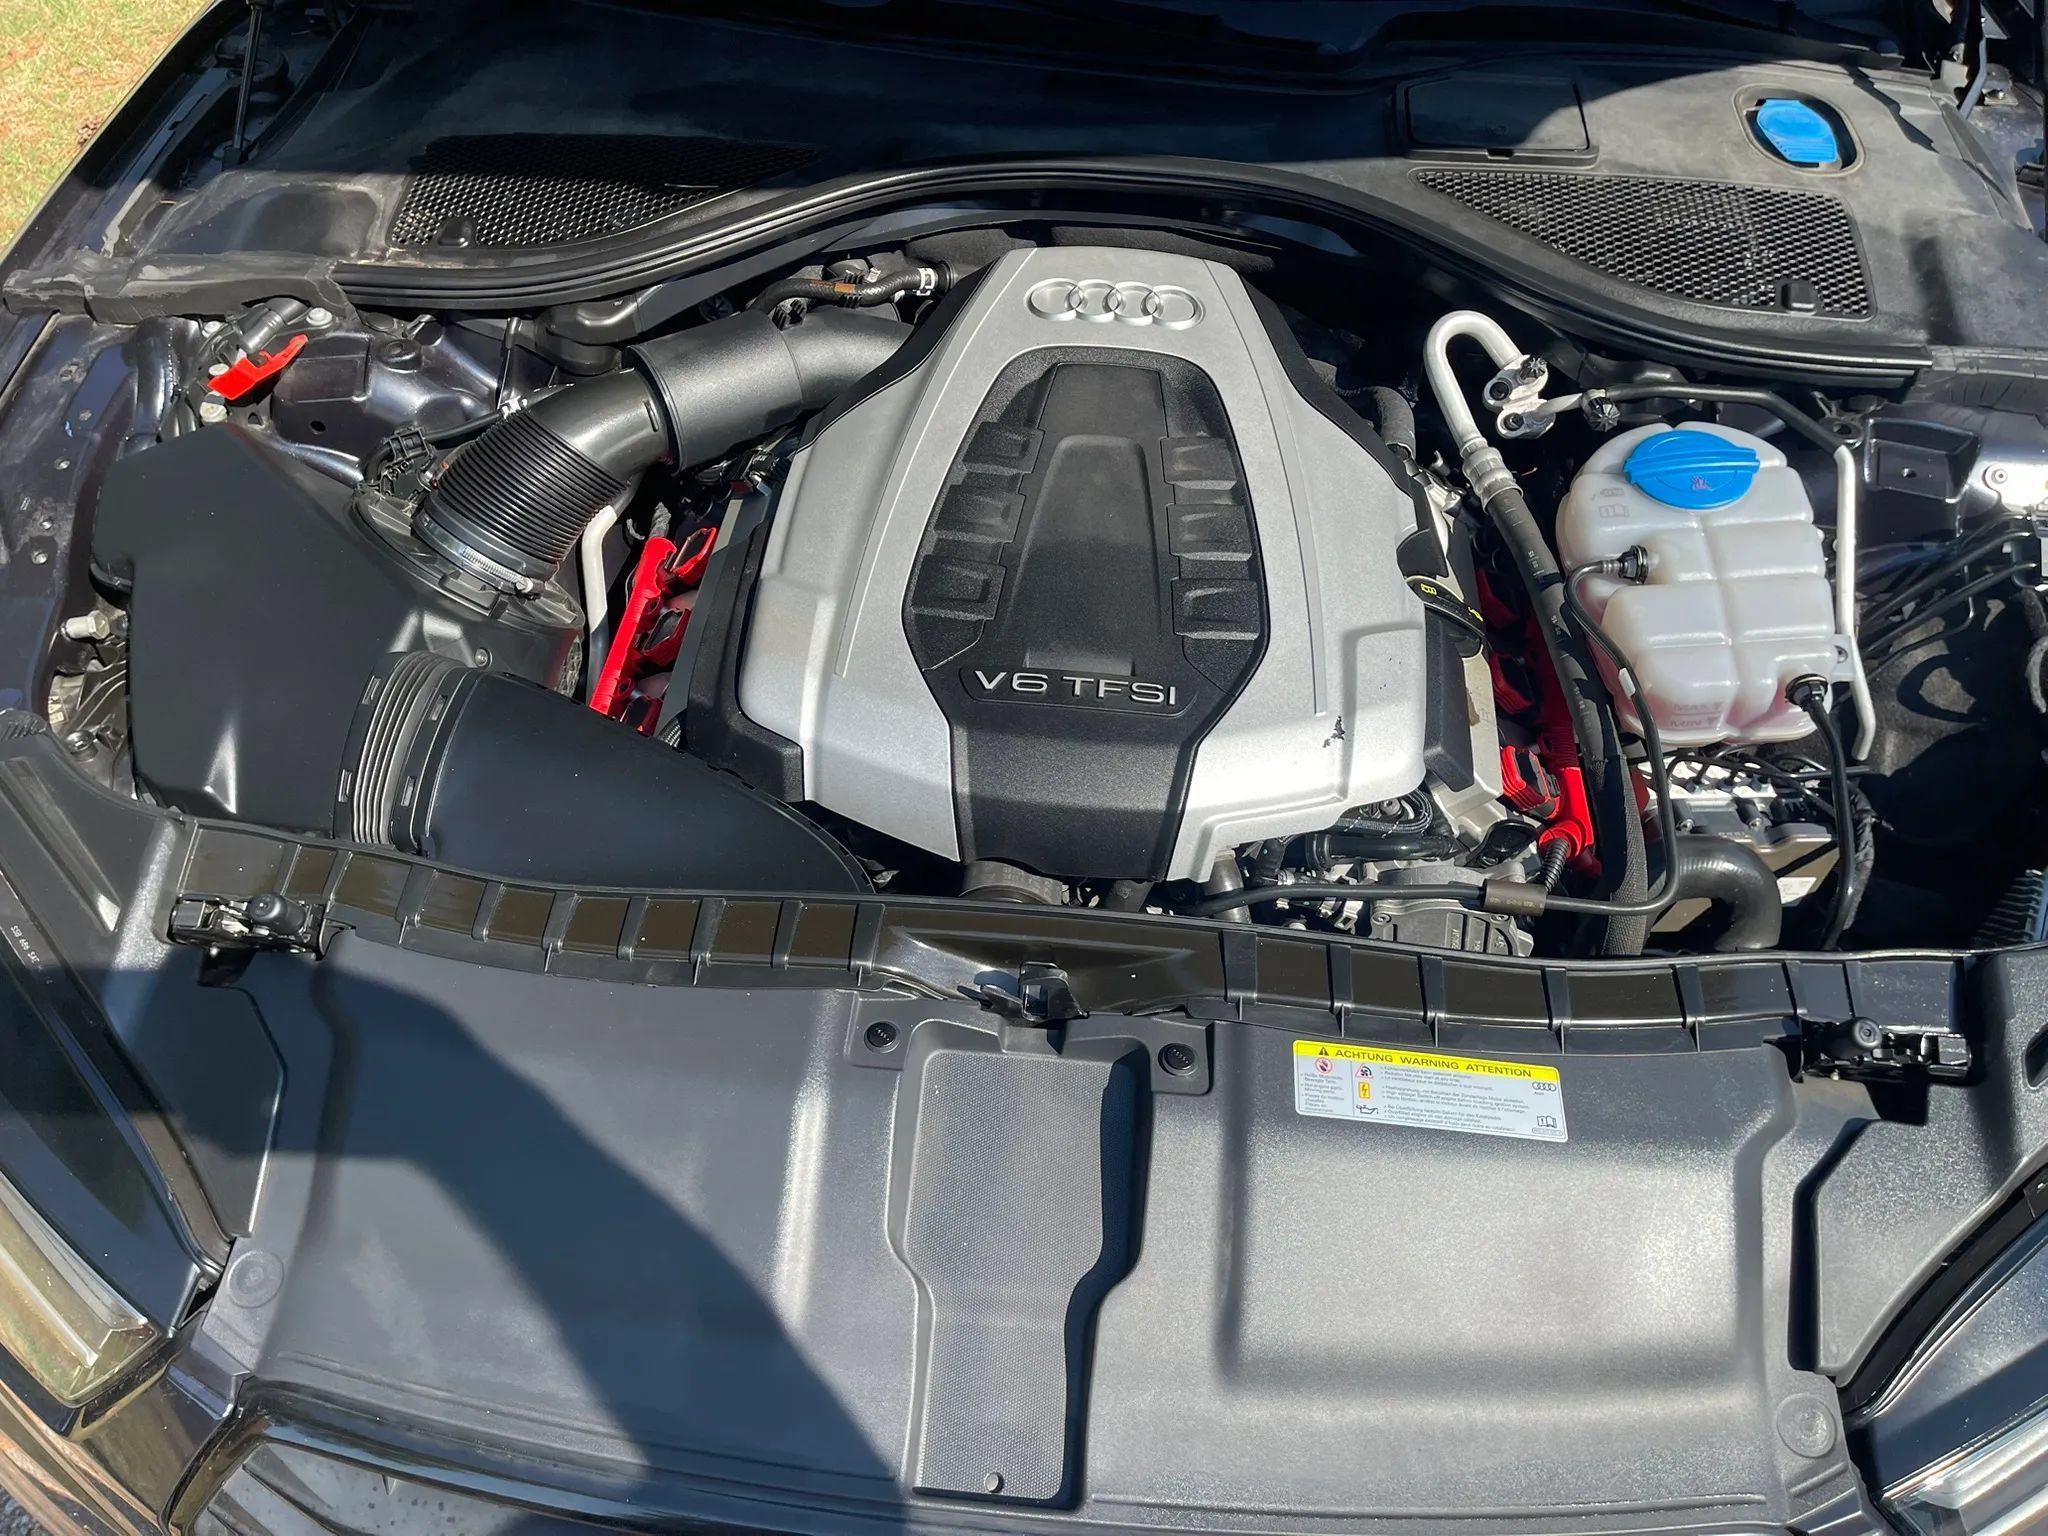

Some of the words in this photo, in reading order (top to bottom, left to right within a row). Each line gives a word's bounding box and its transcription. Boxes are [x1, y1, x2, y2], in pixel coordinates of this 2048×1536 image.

[974, 670, 1049, 692] V6
[1062, 676, 1176, 705] TFSI
[1335, 1049, 1394, 1063] ACHTUNG
[1400, 1056, 1460, 1070] WARNING
[1466, 1063, 1532, 1078] ATTENTION
